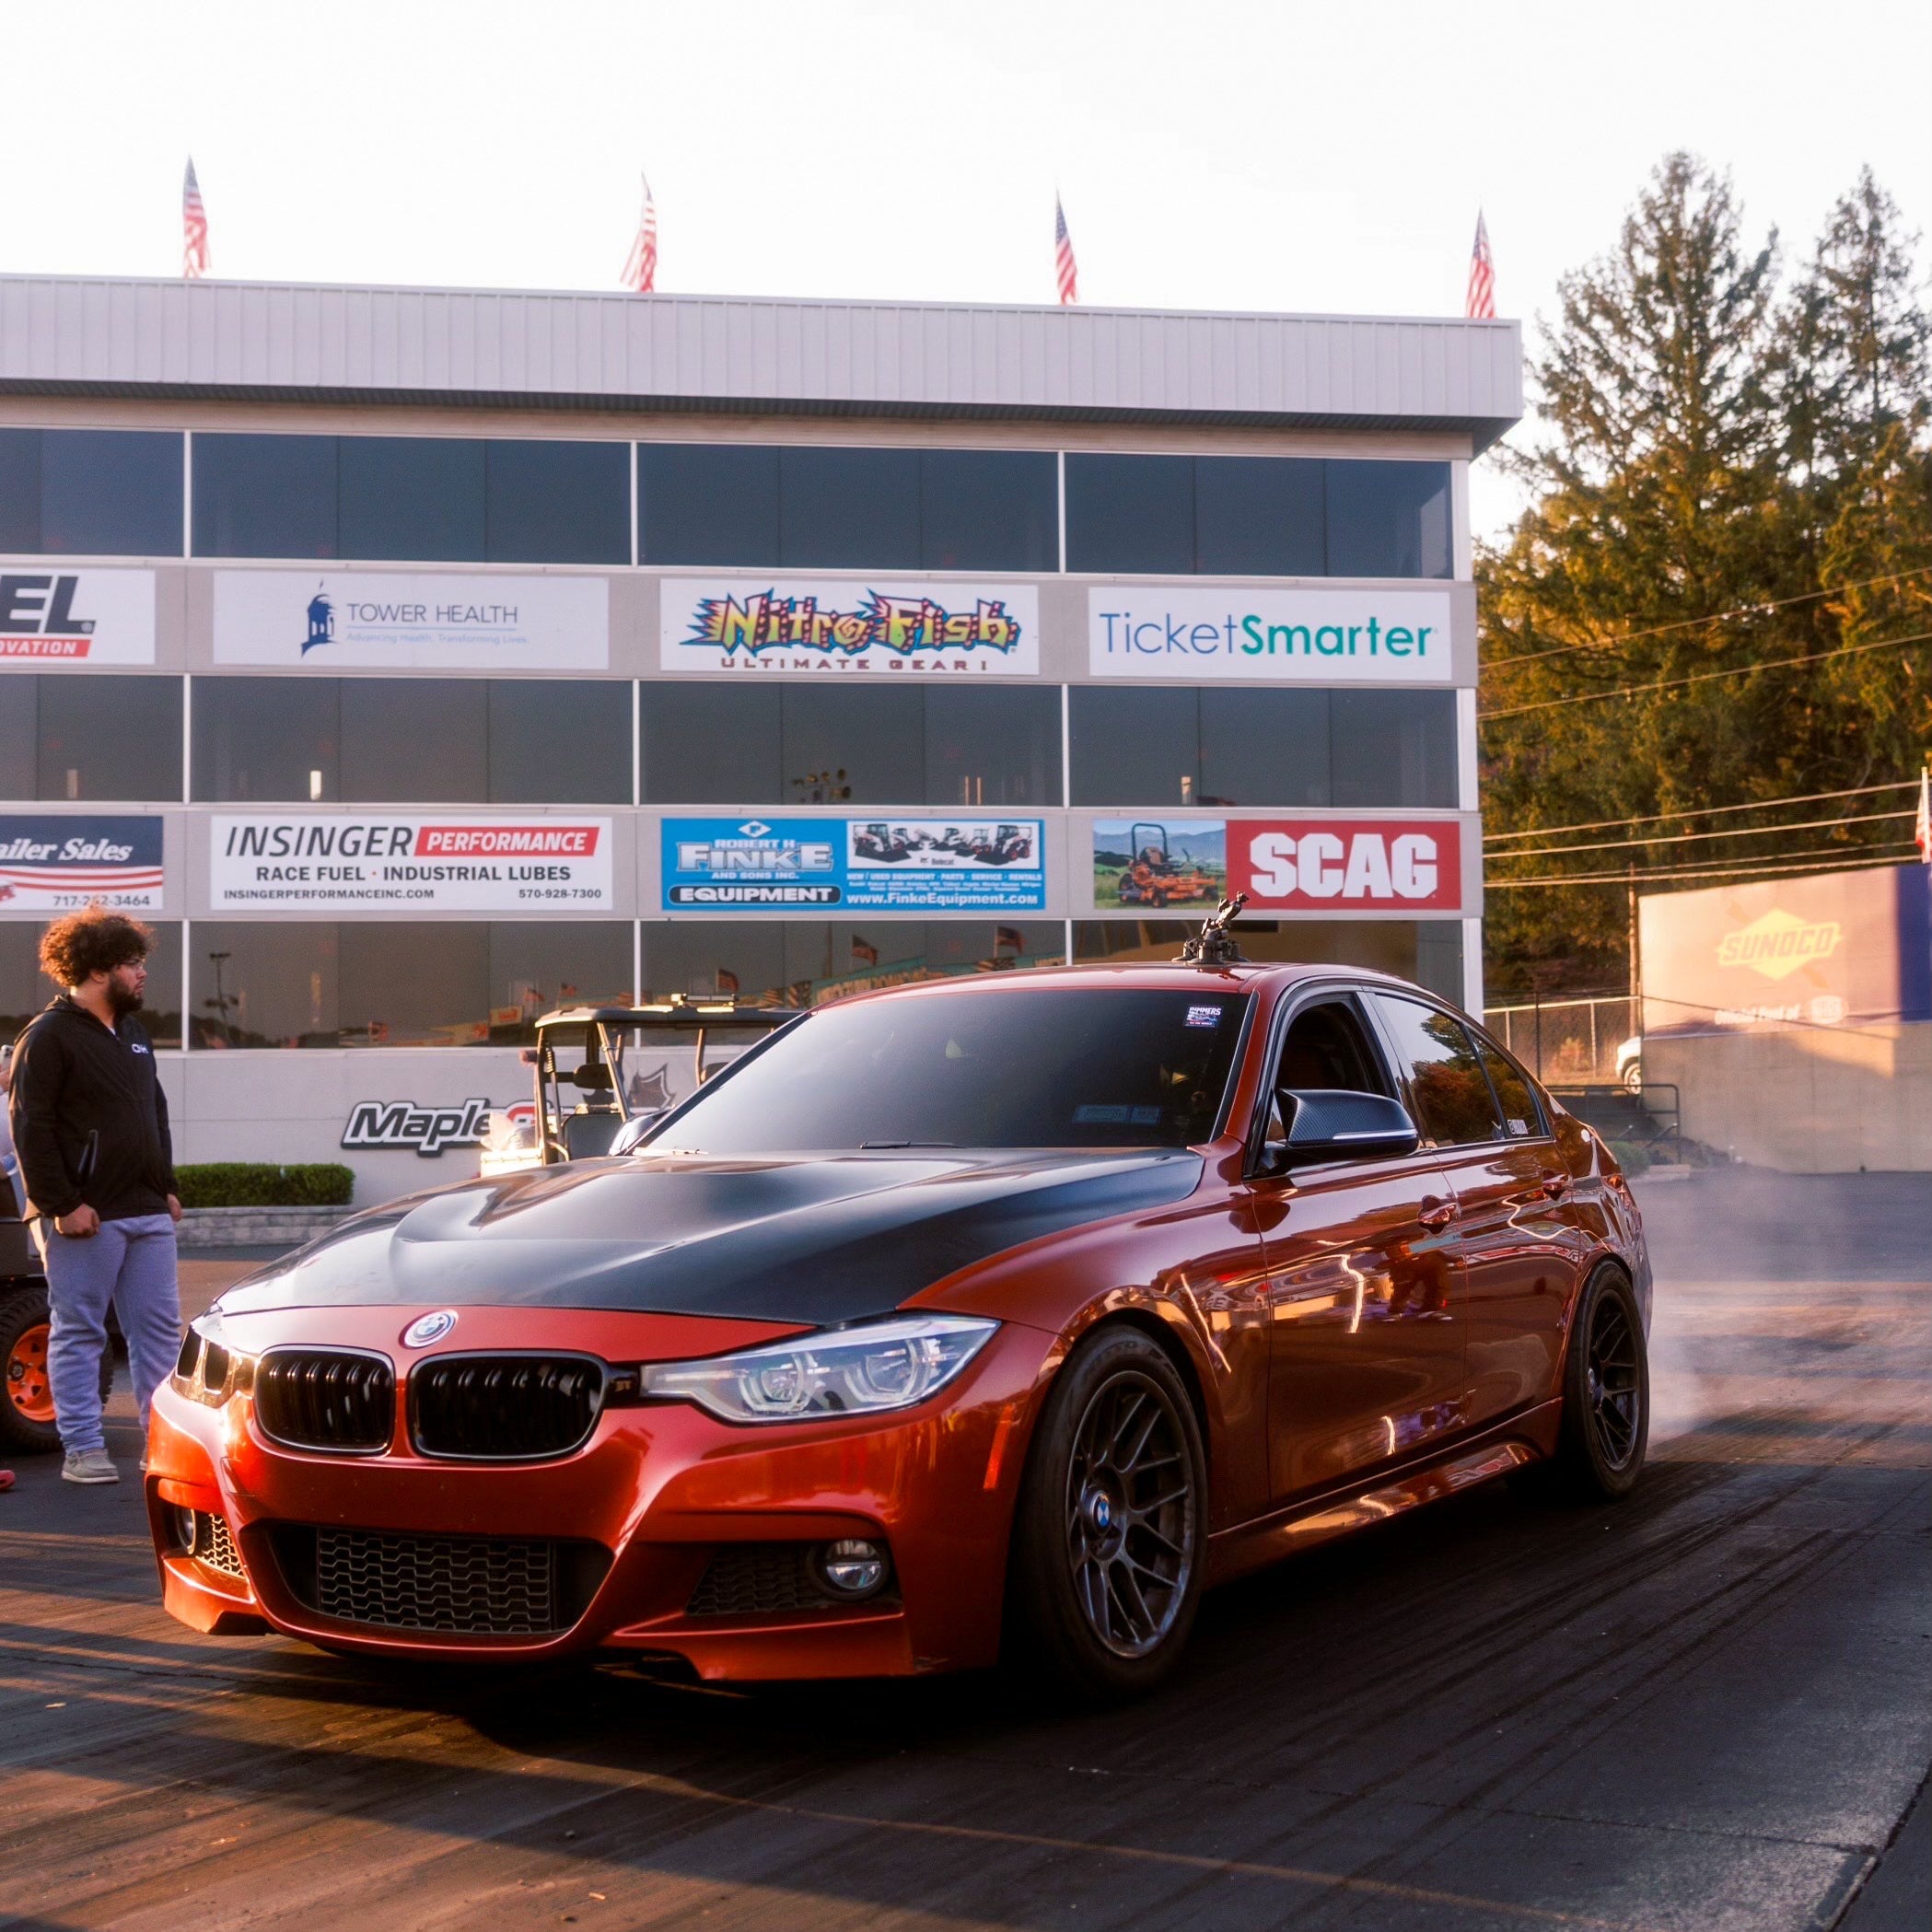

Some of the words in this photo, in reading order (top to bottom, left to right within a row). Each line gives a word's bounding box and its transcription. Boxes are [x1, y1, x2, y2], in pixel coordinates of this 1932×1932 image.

[346, 603, 426, 623] TOWER
[436, 604, 518, 623] HEALTH
[1099, 611, 1433, 657] TicketSmarter
[721, 658, 870, 670] ULTIMATE
[58, 837, 134, 862] Sales
[226, 826, 413, 856] INSINGER
[426, 832, 588, 851] PERFORMANCE
[715, 839, 779, 848] ROBERT
[679, 844, 832, 870] FINKE
[1250, 832, 1437, 898] SCAG
[256, 867, 310, 880] RACE
[317, 867, 366, 881] FUEL
[383, 867, 502, 880] INDUSTRIAL
[508, 867, 571, 880] LUBES
[53, 895, 150, 906] 717-22-3464
[224, 890, 435, 899] INSINGERPERFORMANCEINC.COM
[518, 889, 601, 899] 570-928-7300
[680, 888, 832, 902] EQUIPMENT
[1720, 926, 1834, 963] SUNOCO
